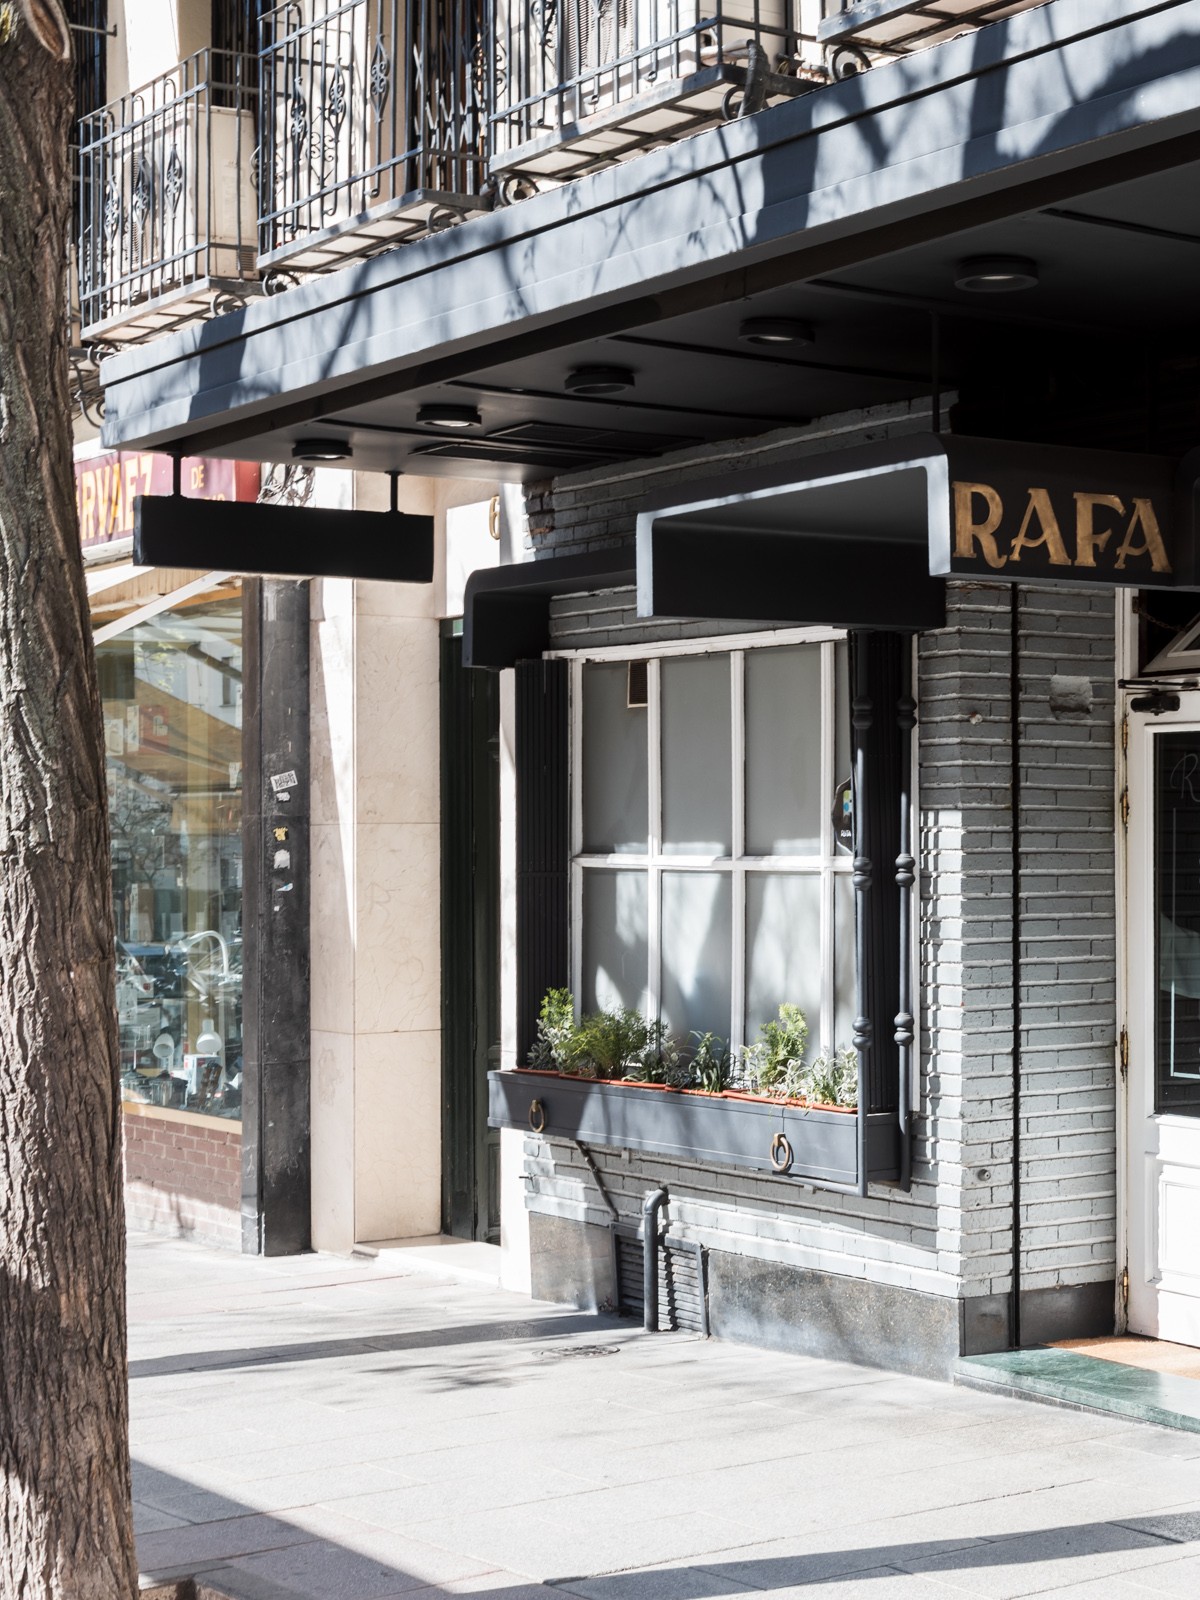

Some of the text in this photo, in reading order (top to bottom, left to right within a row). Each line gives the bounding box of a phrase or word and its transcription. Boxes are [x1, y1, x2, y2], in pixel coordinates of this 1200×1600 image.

[76, 453, 154, 541] RVAEZ
[191, 465, 205, 490] DE
[951, 480, 1173, 574] RAFA
